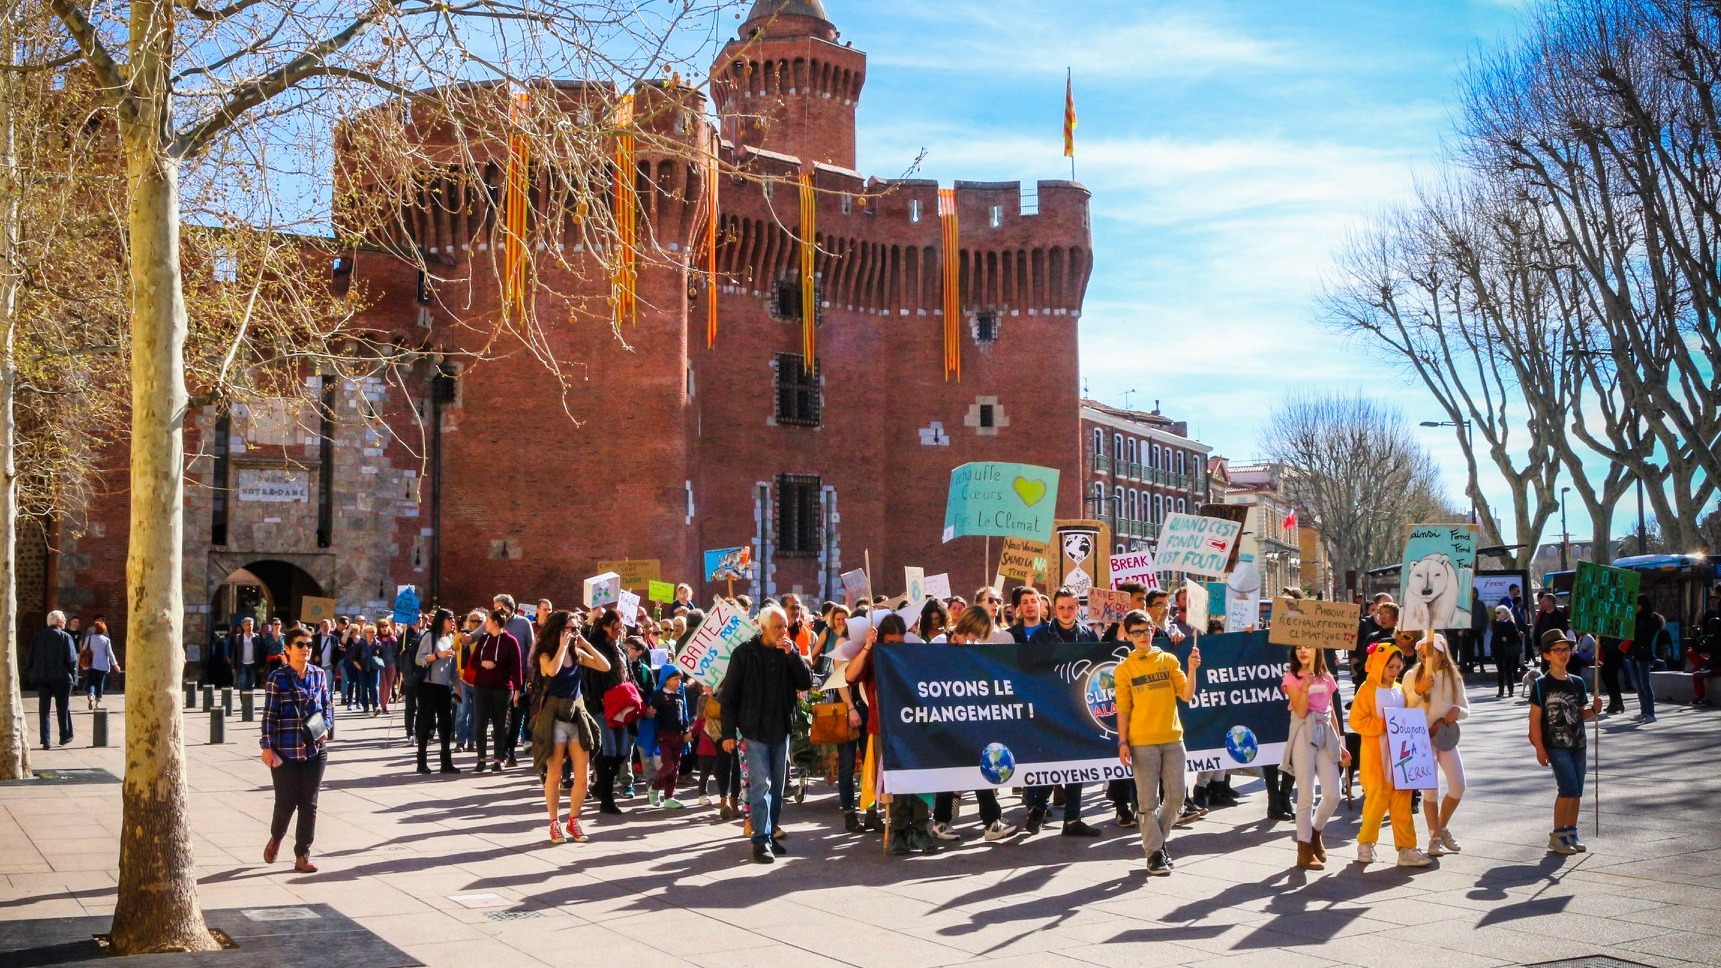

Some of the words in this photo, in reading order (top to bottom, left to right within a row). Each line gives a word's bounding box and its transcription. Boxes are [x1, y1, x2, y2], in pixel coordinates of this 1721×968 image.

[242, 487, 305, 497] NOTRE-DAME
[995, 510, 1041, 533] Climat
[1169, 517, 1208, 533] QUAND
[1209, 520, 1239, 538] C'EST
[1166, 535, 1205, 549] FONDU
[1409, 530, 1441, 539] ainsi
[1450, 528, 1471, 541] Fond
[1452, 543, 1471, 553] Fond
[1110, 556, 1149, 572] BREAK
[1181, 551, 1227, 571] FOUTU
[1114, 573, 1158, 589] ETH
[1484, 580, 1506, 589] free
[1289, 629, 1341, 640] CLIMATIQUE
[703, 666, 723, 687] LA
[1145, 671, 1169, 683] STREET
[1206, 662, 1292, 684] RELEVONS
[917, 680, 990, 698] SOYONS
[994, 679, 1014, 696] LE
[1188, 688, 1228, 709] DÉFI
[1230, 686, 1289, 705] CLIMA
[900, 703, 1024, 723] CHANGEMENT
[1028, 702, 1034, 719] !
[1400, 740, 1418, 760] LA
[1024, 767, 1101, 786] CITOYENS
